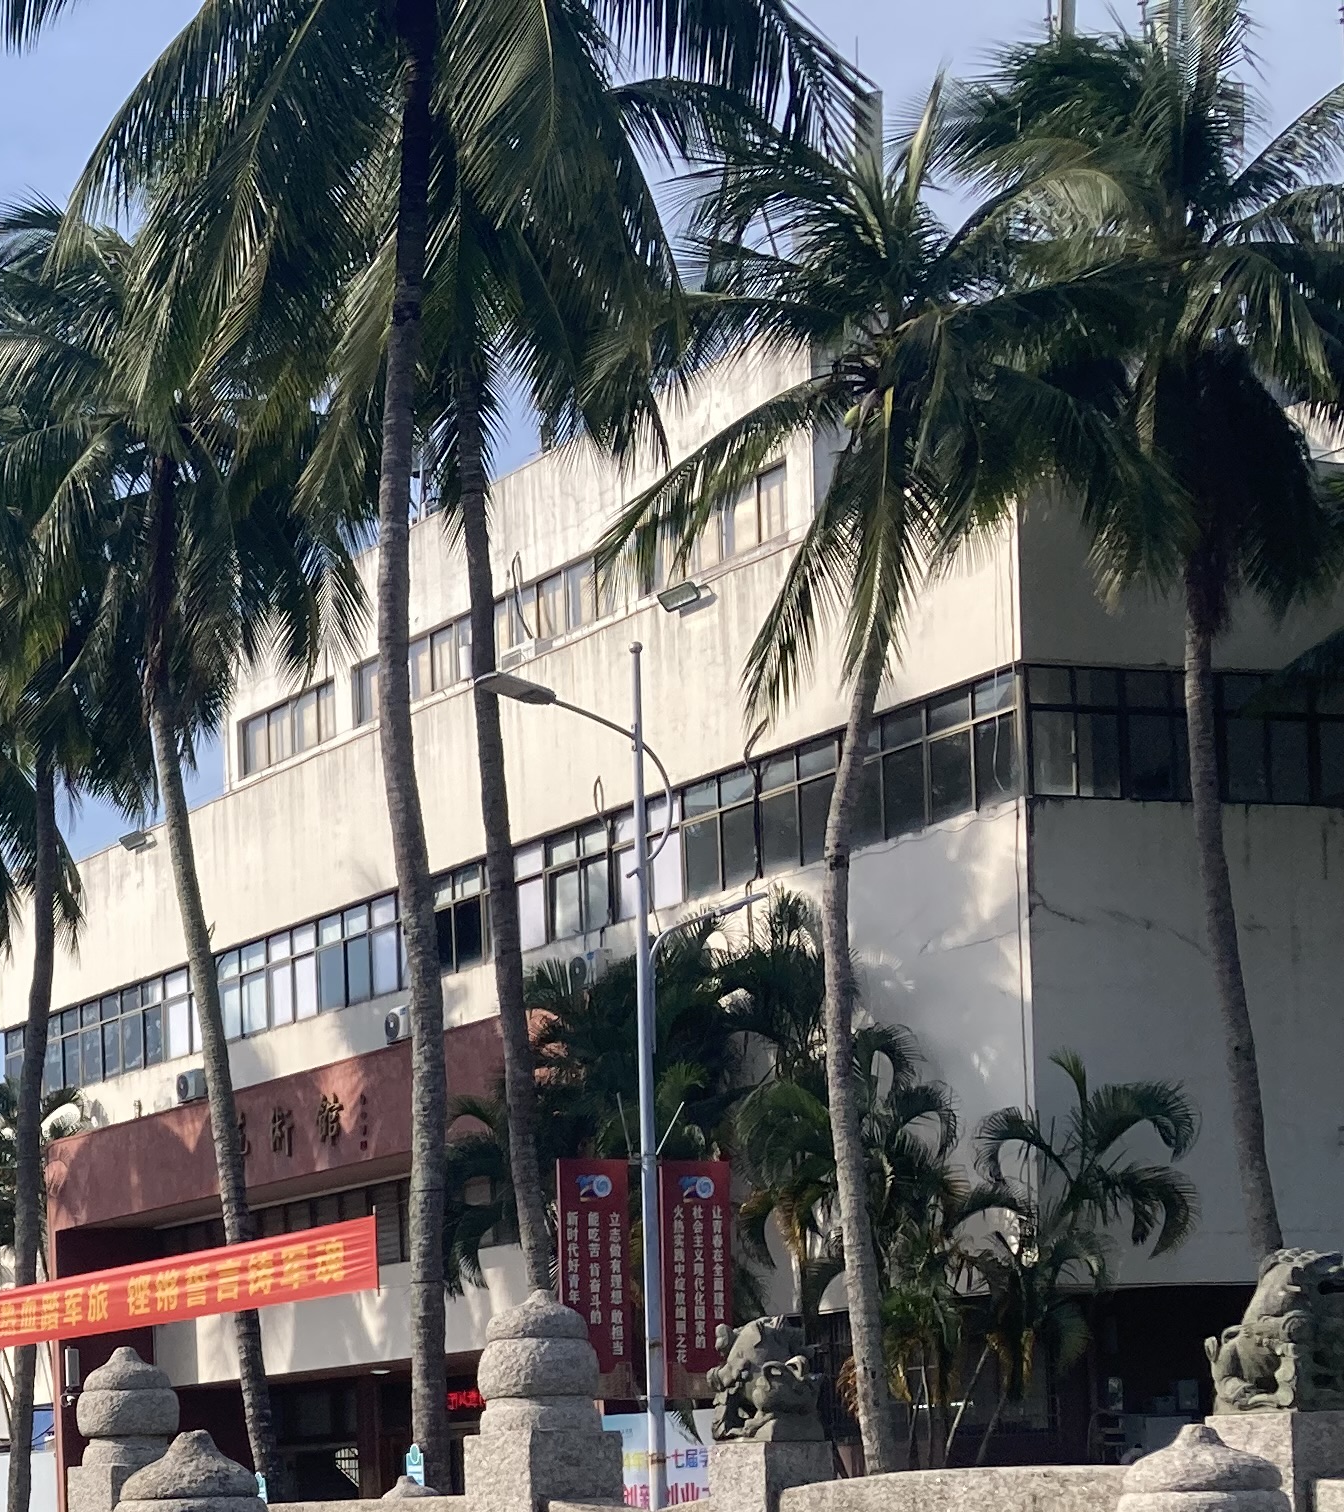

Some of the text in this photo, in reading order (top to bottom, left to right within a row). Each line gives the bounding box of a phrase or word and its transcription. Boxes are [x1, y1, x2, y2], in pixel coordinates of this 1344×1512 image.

[692, 1204, 706, 1349] 社会主义现代化国家的
